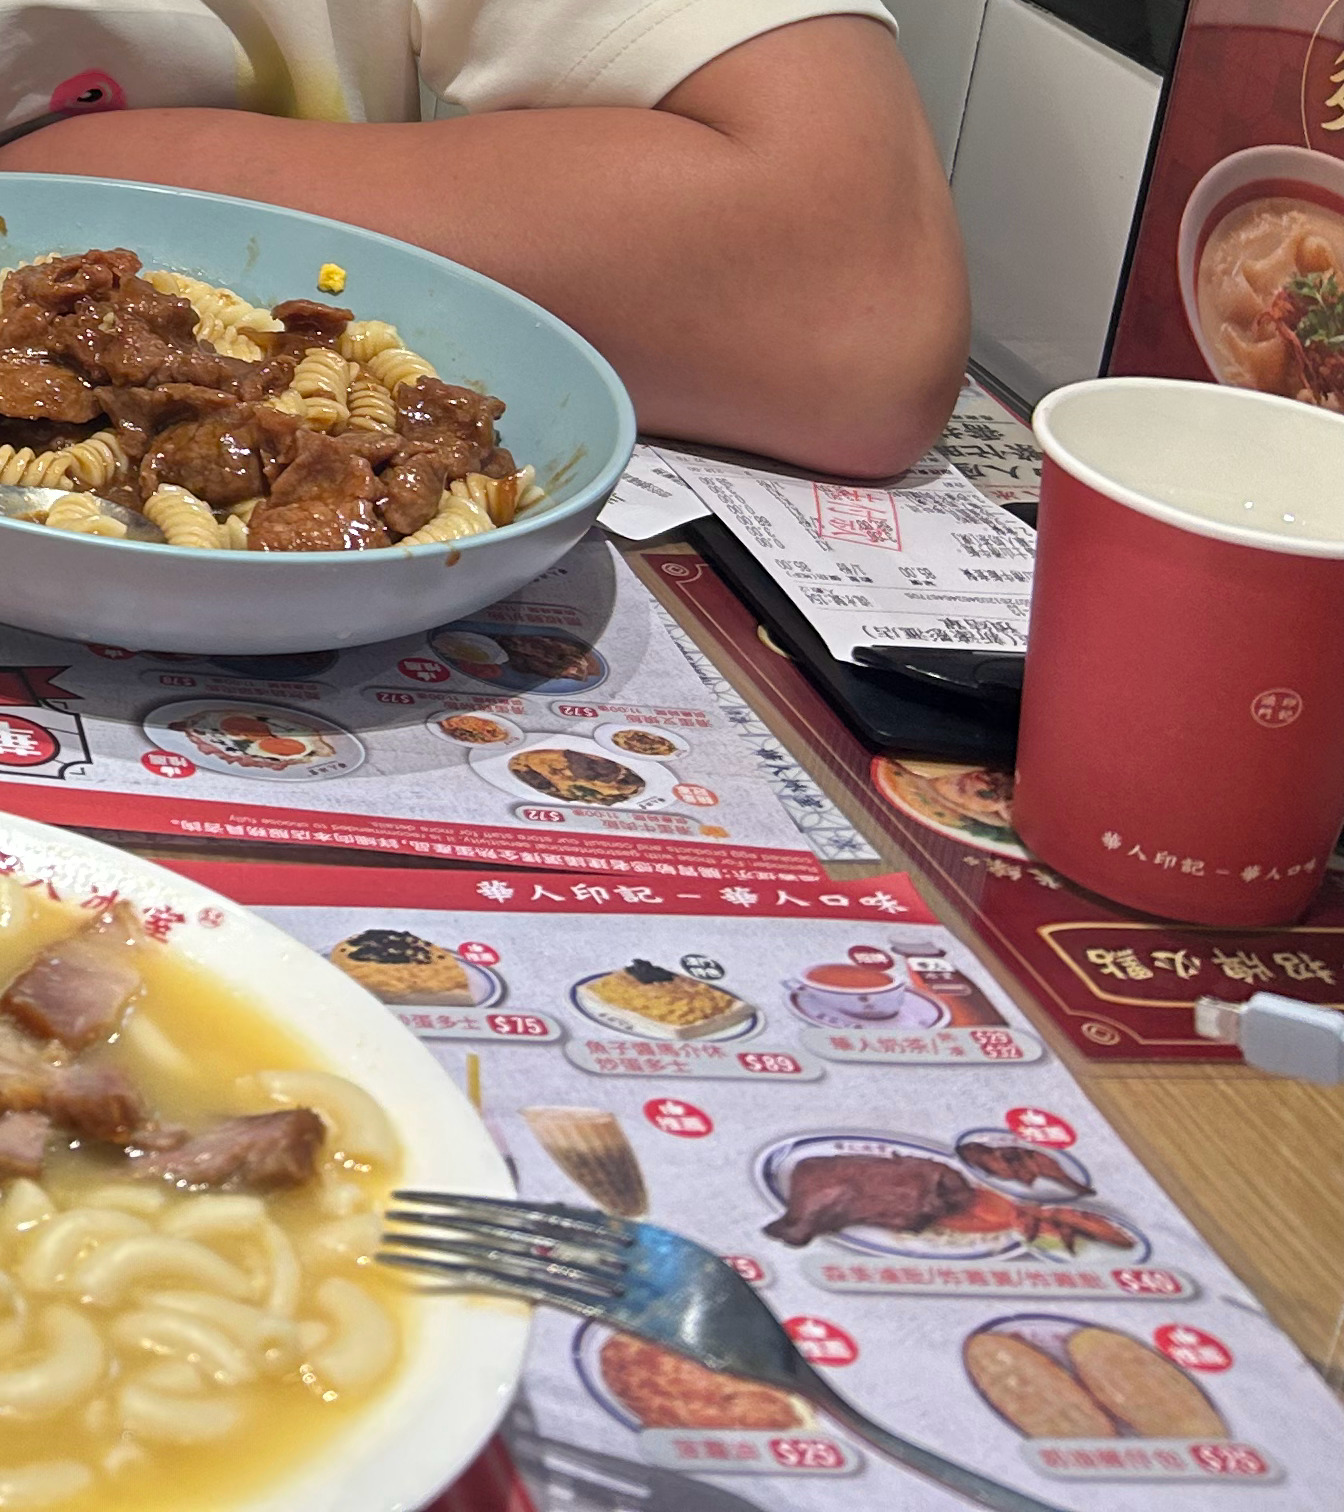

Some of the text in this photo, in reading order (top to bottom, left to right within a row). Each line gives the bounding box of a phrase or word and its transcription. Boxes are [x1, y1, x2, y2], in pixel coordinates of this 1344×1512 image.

[379, 691, 412, 705] $72
[560, 706, 595, 718] $72
[525, 809, 562, 823] $72
[1100, 830, 1205, 877] 華人印記
[476, 878, 909, 916] 華人印記 華人口味
[1085, 947, 1337, 987] 招牌必點
[493, 1016, 546, 1036] $75
[742, 1052, 797, 1074] $89
